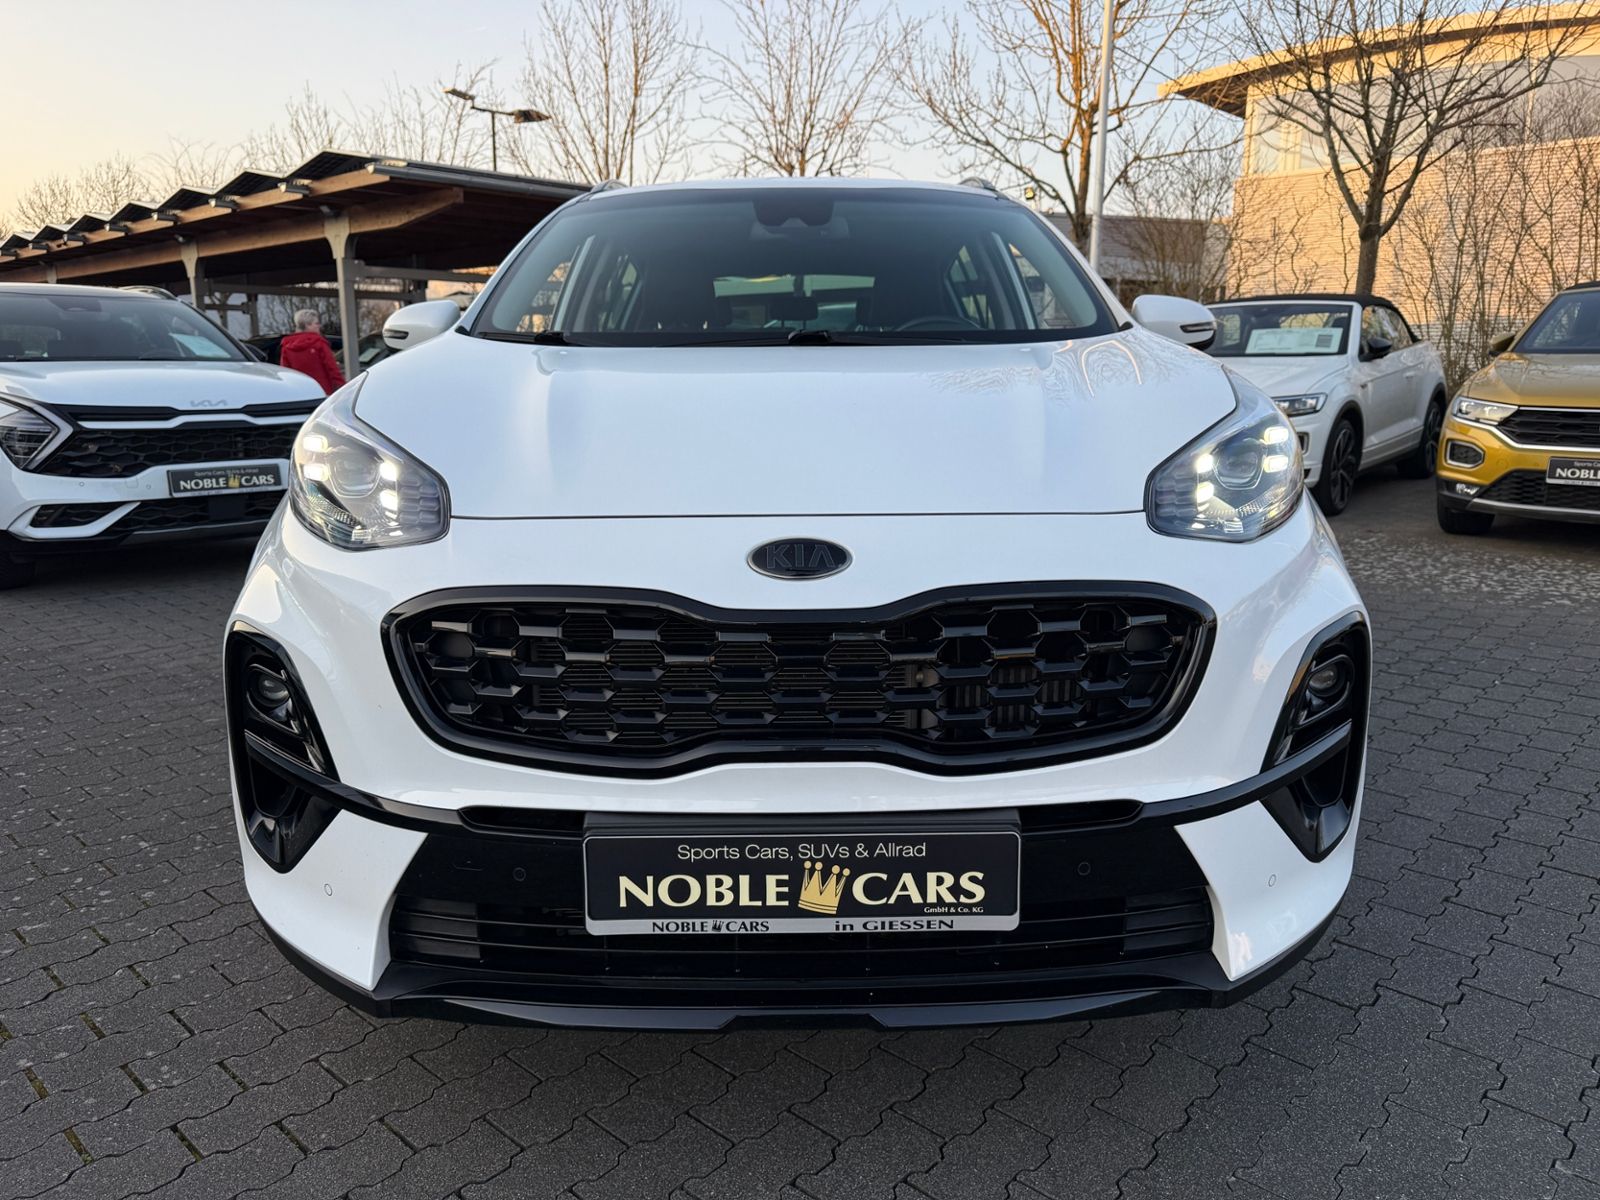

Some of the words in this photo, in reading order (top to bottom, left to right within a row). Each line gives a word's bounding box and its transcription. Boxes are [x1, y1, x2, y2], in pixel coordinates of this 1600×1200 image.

[180, 477, 227, 491] NOBLE
[241, 474, 275, 487] CARS
[764, 543, 836, 569] KIA
[677, 844, 740, 863] Sports
[745, 843, 794, 861] Cars,
[798, 842, 850, 859] SUVs
[855, 842, 870, 858] &
[873, 842, 926, 858] Allrad
[618, 873, 790, 908] NOBLE
[852, 871, 986, 906] CARS
[923, 906, 949, 914] GmbH
[949, 906, 956, 914] &
[957, 906, 971, 914] Co.
[972, 906, 984, 914] KG
[652, 920, 708, 933] NOBLE
[725, 920, 770, 932] CARS
[835, 920, 855, 932] in
[862, 919, 954, 931] GIESSEN
